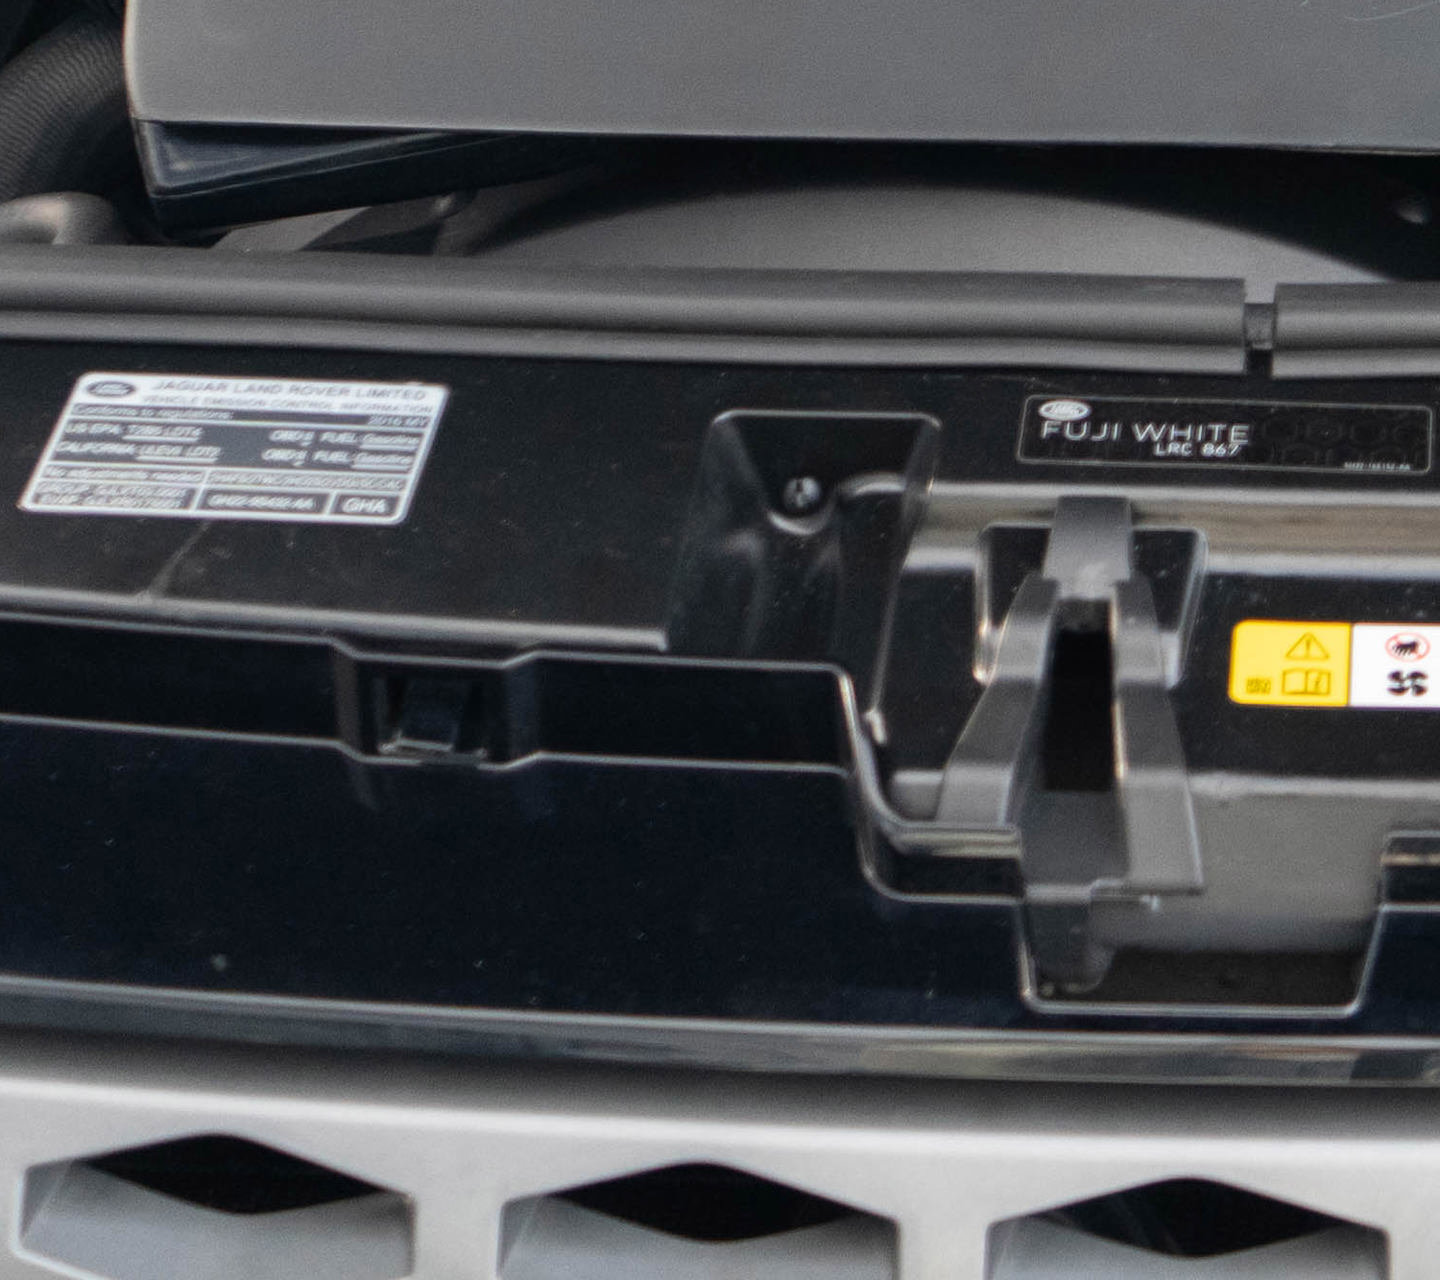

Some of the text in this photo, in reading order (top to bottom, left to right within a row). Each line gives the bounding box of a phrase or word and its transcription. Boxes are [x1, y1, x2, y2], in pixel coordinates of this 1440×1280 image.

[157, 381, 427, 400] JAGUAR LAND ROVER LIMITED
[1041, 420, 1249, 445] FUJI WHITE
[1154, 442, 1242, 457] LRC 867
